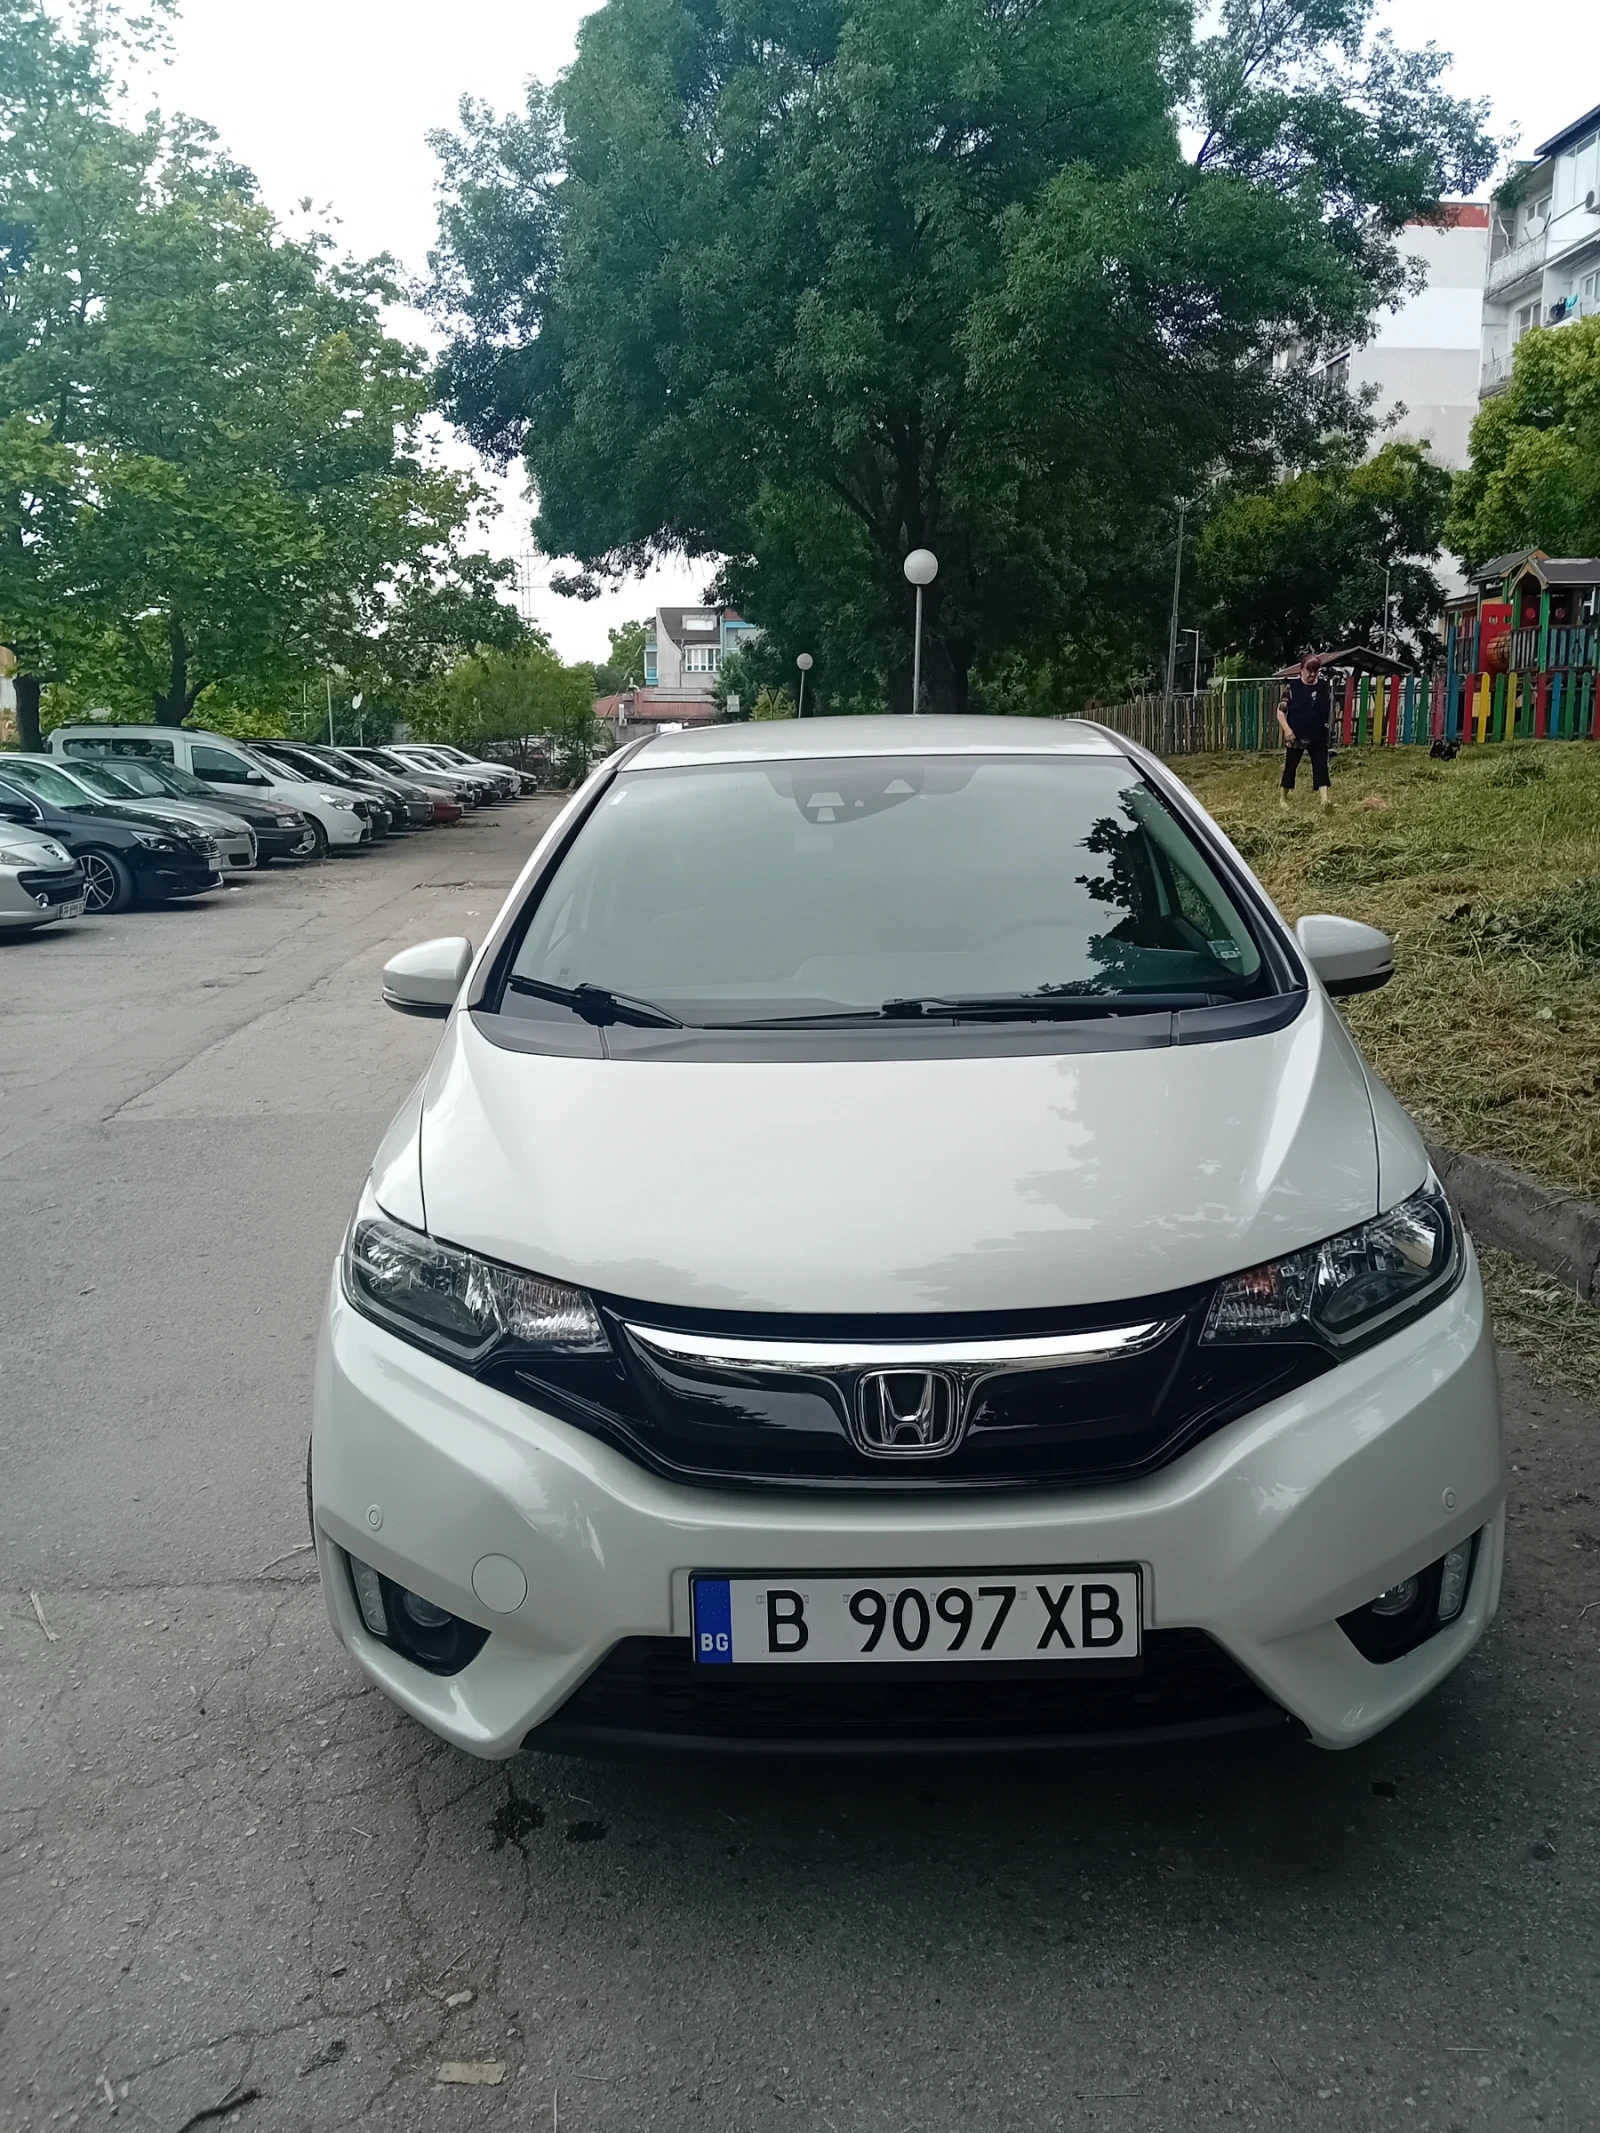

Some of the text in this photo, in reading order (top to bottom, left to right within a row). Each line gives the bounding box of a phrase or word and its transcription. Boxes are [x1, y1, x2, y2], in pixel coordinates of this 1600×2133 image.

[767, 1583, 1124, 1653] B 9097 XB
[701, 1633, 729, 1652] BG
